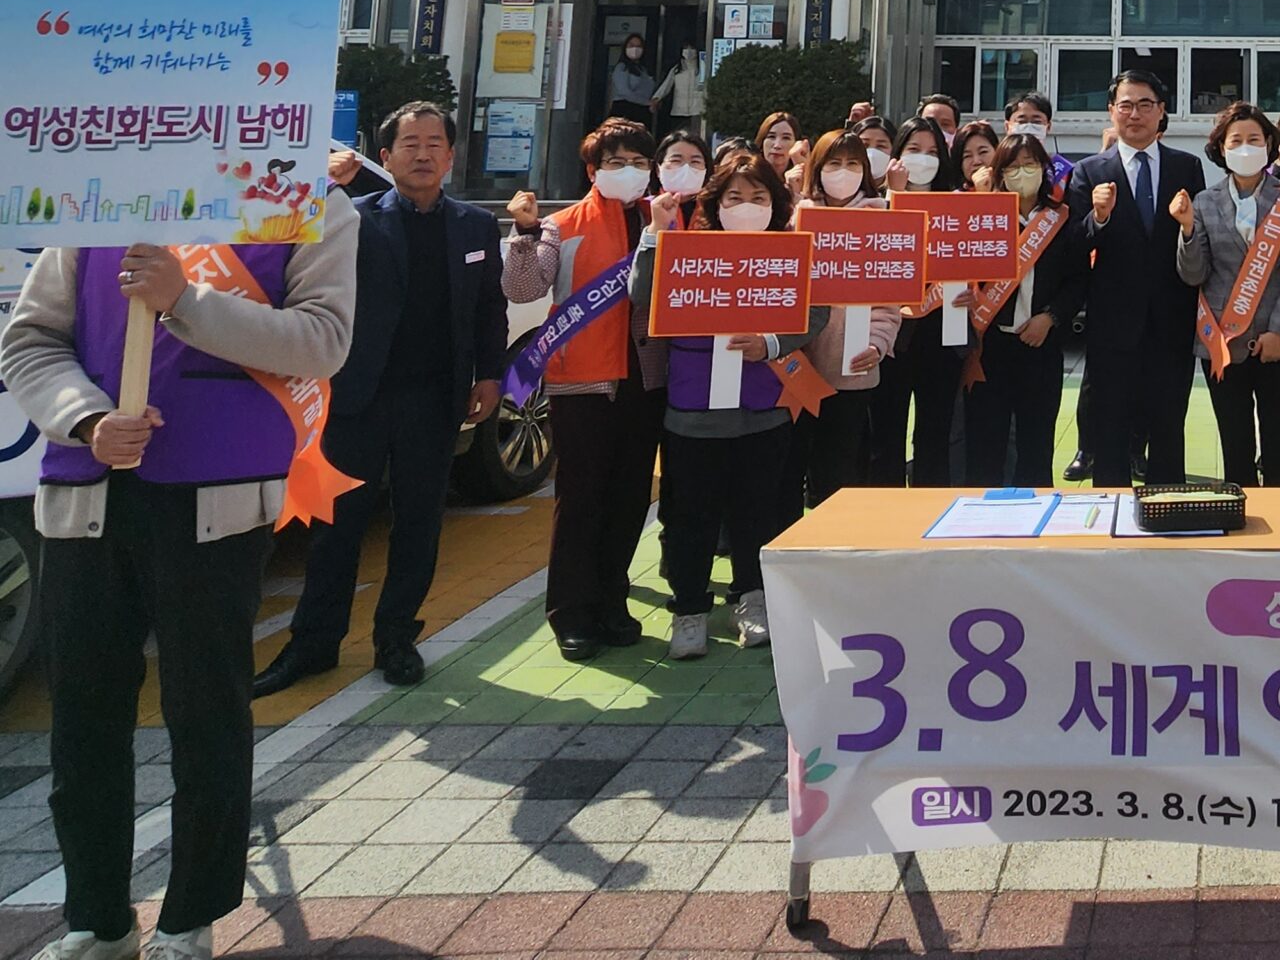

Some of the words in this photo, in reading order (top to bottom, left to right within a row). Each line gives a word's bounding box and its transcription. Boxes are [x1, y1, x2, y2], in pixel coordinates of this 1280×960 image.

[78, 21, 131, 39] 여성의
[139, 19, 197, 41] 희망찬
[202, 17, 253, 46] 미래를
[92, 52, 135, 74] 함께
[141, 51, 231, 72] 키워나가는
[4, 105, 225, 148] 여성친화도시
[236, 104, 309, 146] 남해
[928, 217, 960, 232] 지는
[967, 215, 1009, 231] 성폭력
[865, 232, 916, 252] 가정폭력
[926, 243, 955, 258] 나는
[958, 241, 1009, 258] 인권존중
[669, 257, 734, 278] 사라지는
[738, 257, 800, 278] 가정폭력
[865, 260, 915, 280] 인권존중
[1233, 243, 1275, 316] 인권존중
[668, 287, 733, 307] 살아나는
[736, 286, 798, 307] 인권존중
[836, 607, 1028, 753] 3.8
[1058, 660, 1241, 757] 세계
[919, 791, 983, 820] 일시
[1002, 789, 1103, 818] 2023.
[1117, 791, 1149, 819] 3.
